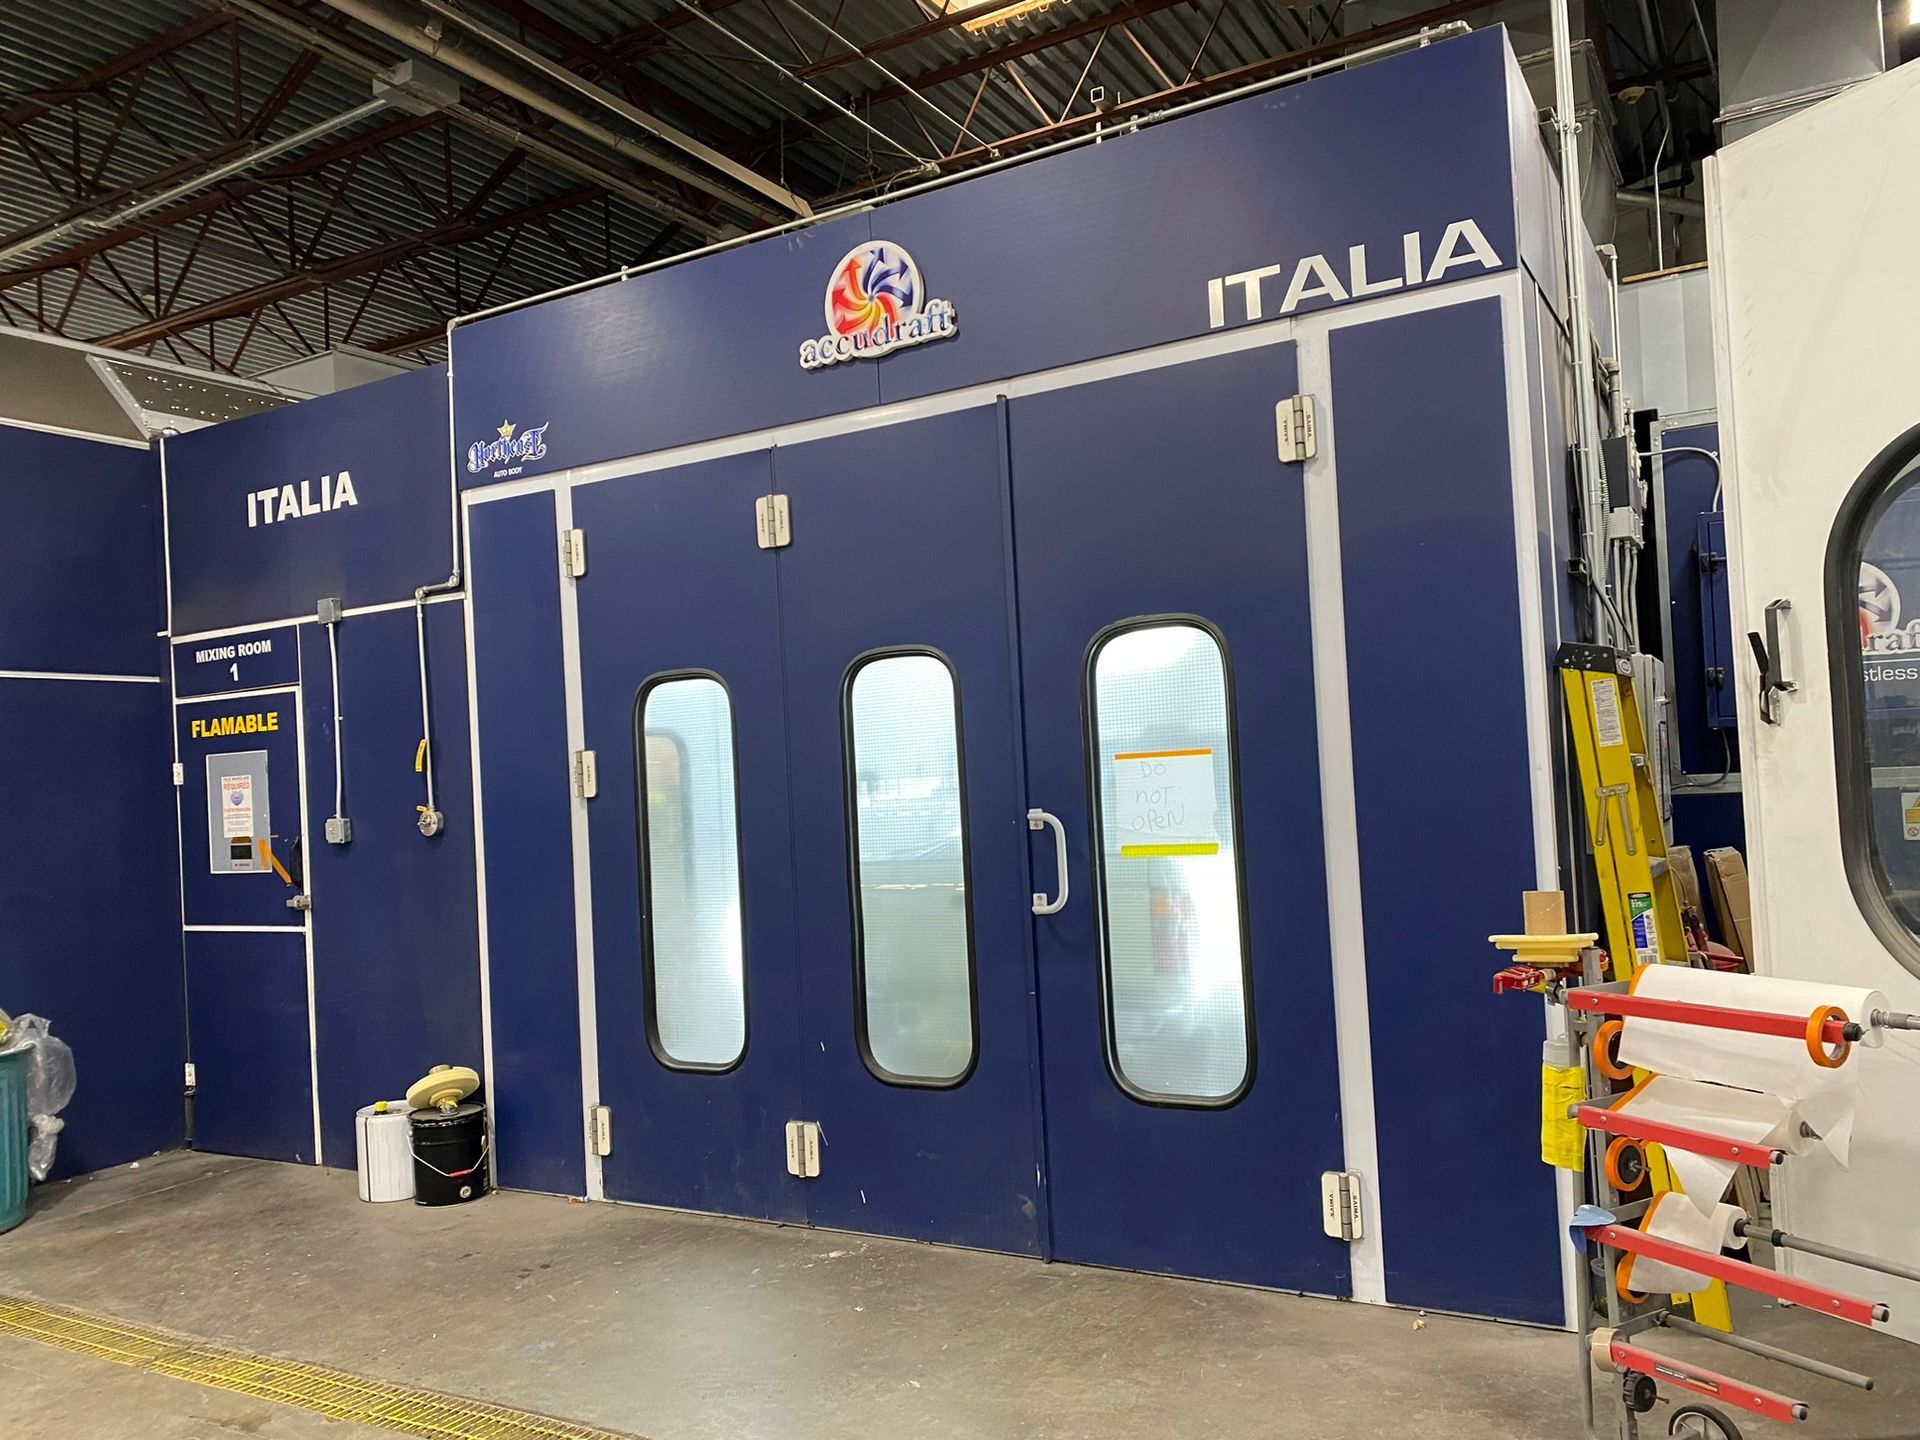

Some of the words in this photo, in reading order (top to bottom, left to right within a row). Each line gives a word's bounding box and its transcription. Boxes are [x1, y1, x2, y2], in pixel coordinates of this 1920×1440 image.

[1208, 219, 1503, 329] ITALIA
[802, 300, 952, 365] accudraft
[493, 469, 508, 478] AUTO
[508, 466, 523, 476] BODY
[247, 471, 358, 528] ITALIA
[195, 646, 236, 664] MIXING
[237, 639, 272, 657] ROOM
[229, 662, 239, 682] 1
[191, 711, 279, 739] FLAMABLE
[1140, 761, 1167, 778] DO
